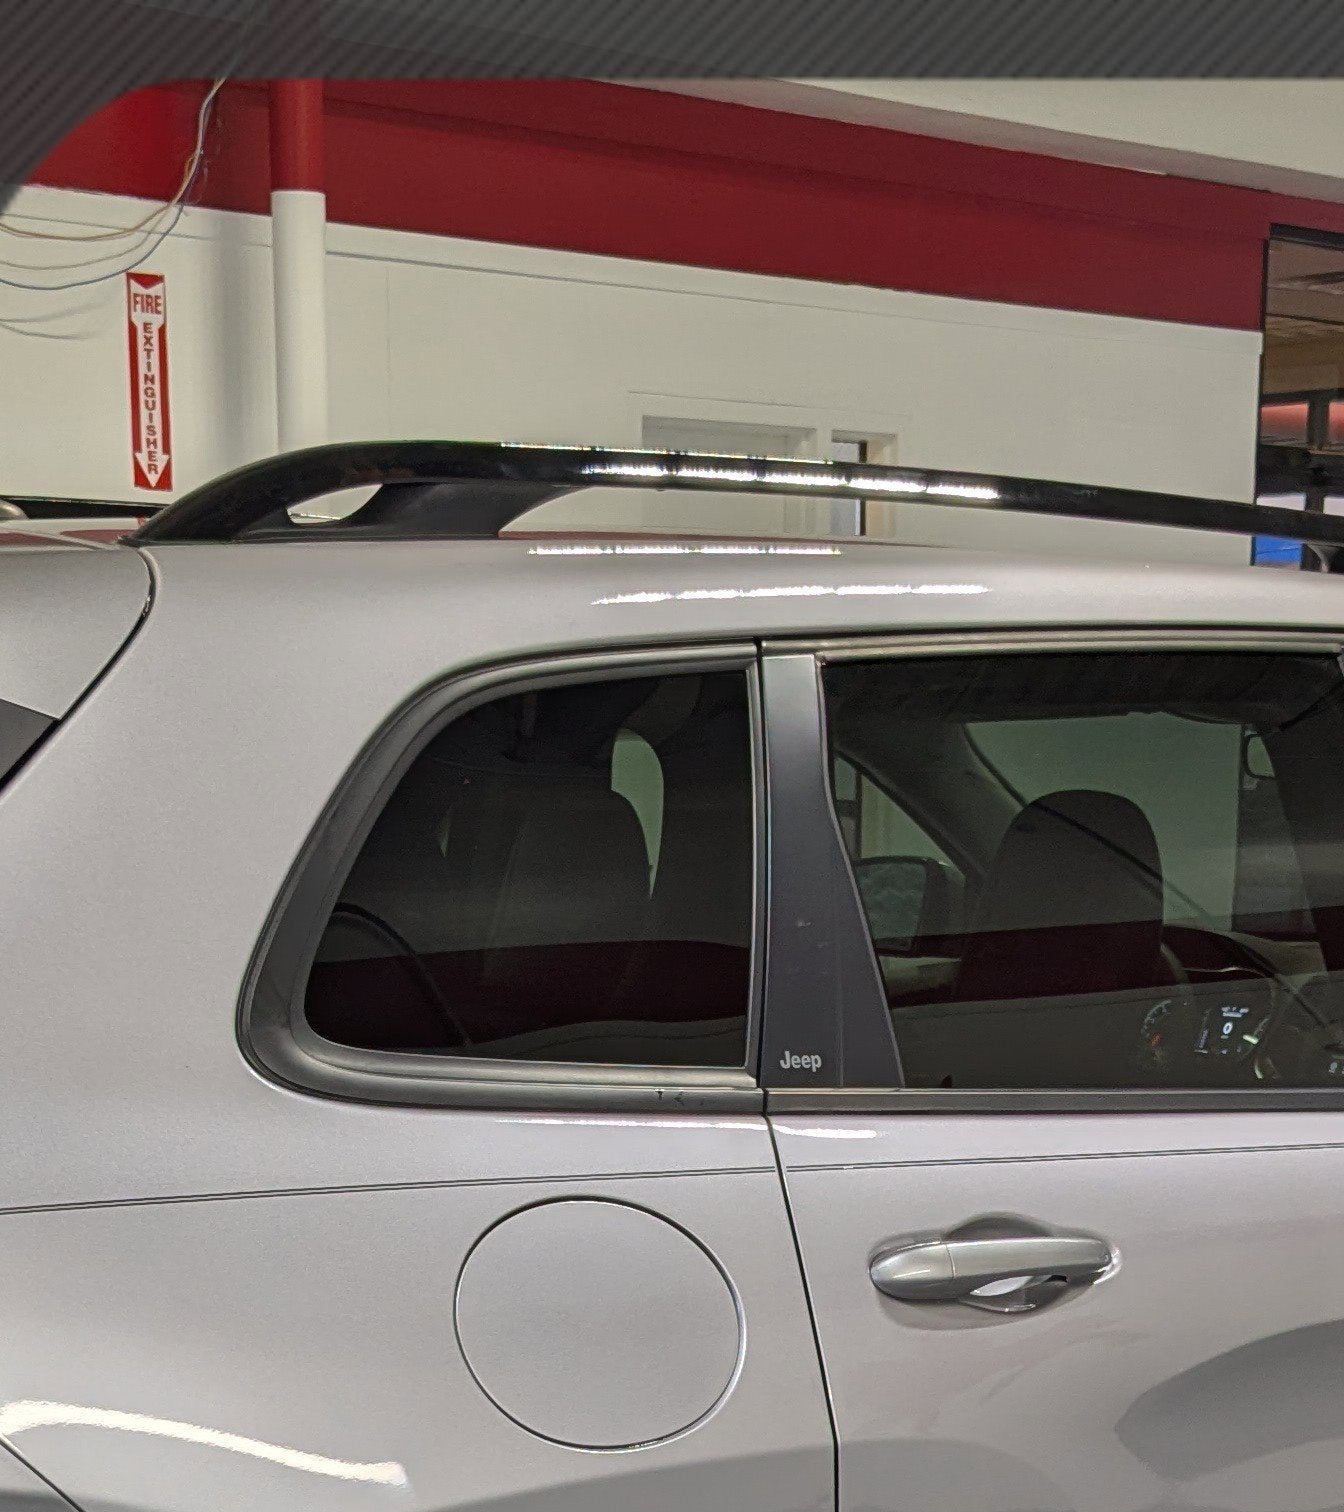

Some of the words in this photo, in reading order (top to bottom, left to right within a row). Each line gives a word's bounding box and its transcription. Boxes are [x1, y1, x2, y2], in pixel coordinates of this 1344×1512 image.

[133, 292, 163, 315] FIRE
[143, 322, 160, 475] EXTINGUISHER
[779, 1050, 822, 1073] Jeep
